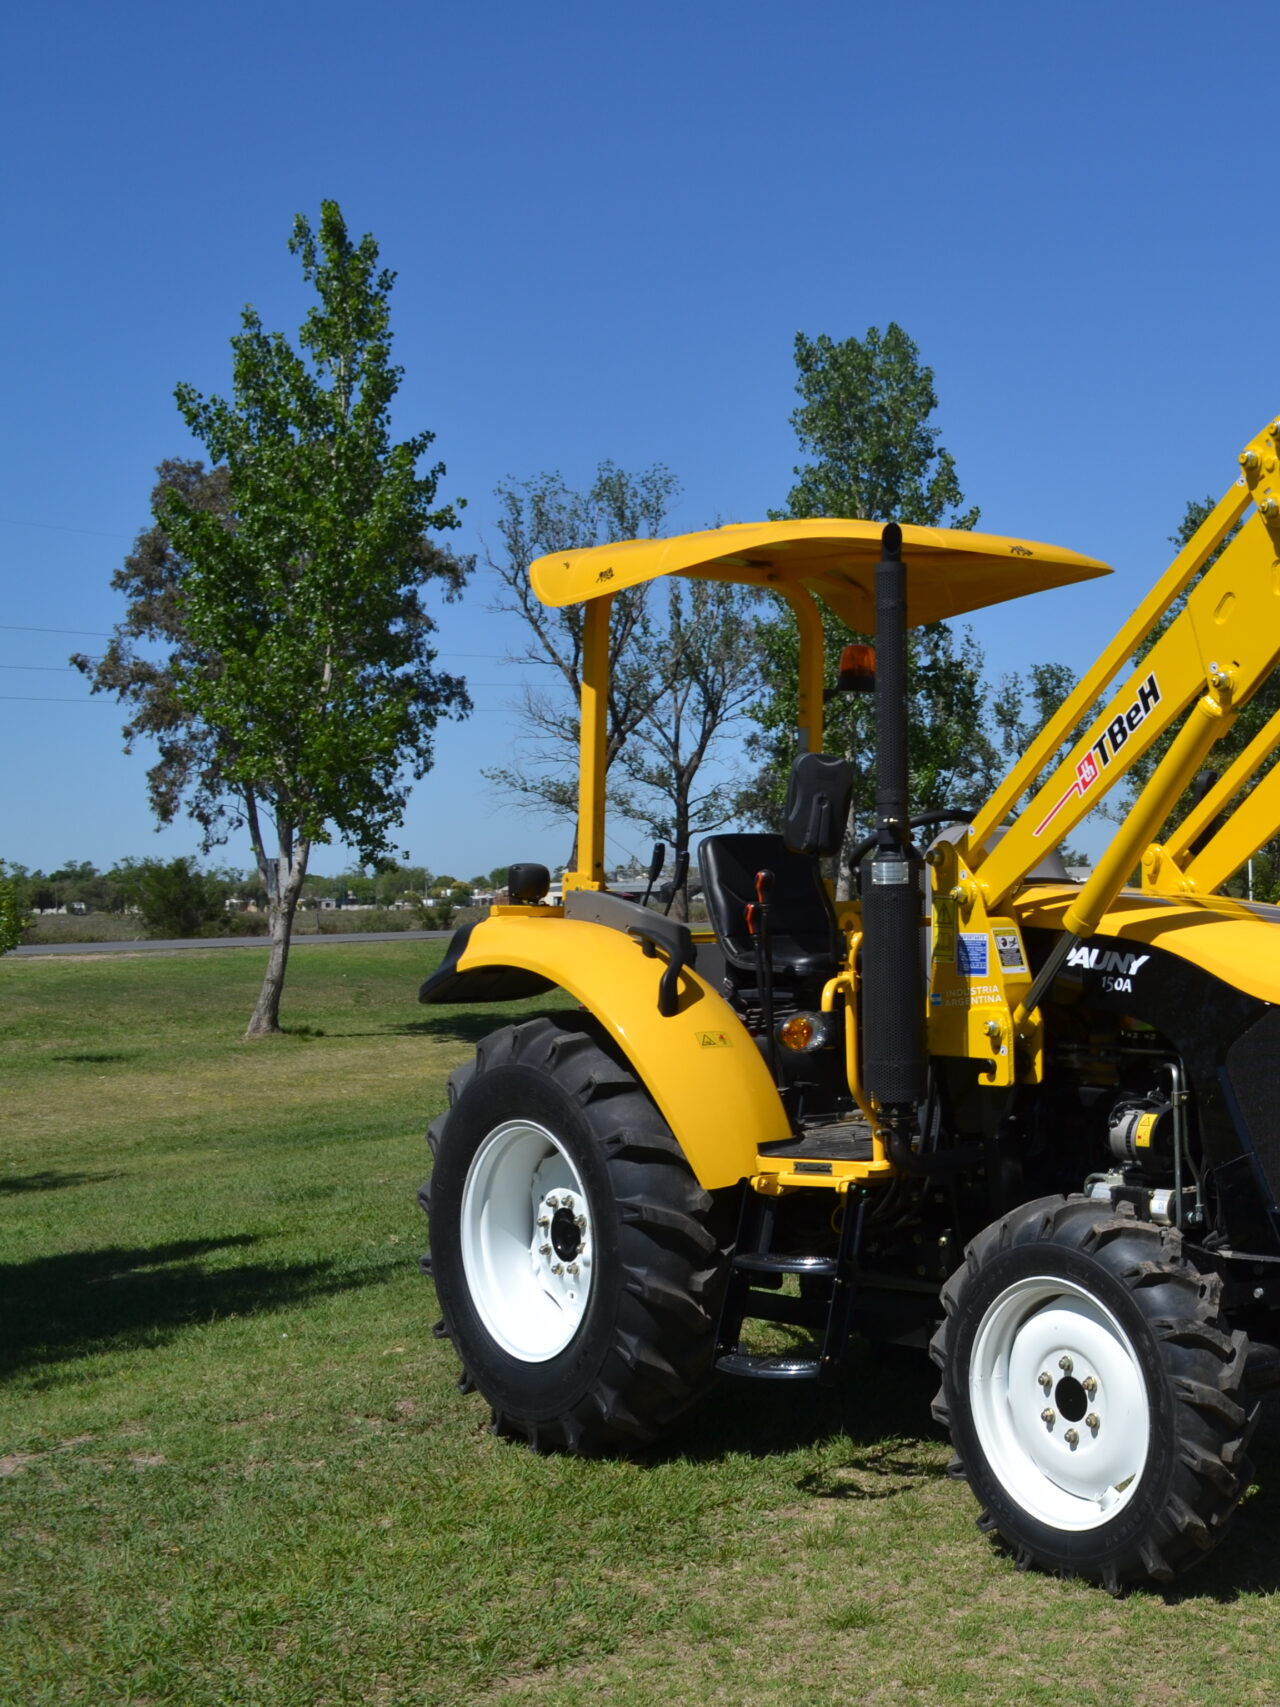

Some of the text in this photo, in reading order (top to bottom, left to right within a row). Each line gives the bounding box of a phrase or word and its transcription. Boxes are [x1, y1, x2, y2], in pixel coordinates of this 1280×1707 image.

[1091, 671, 1162, 769] TBeH
[945, 984, 999, 998] INDUSTRIA
[1101, 975, 1132, 993] 150A
[944, 994, 1003, 1008] ARGENTINA
